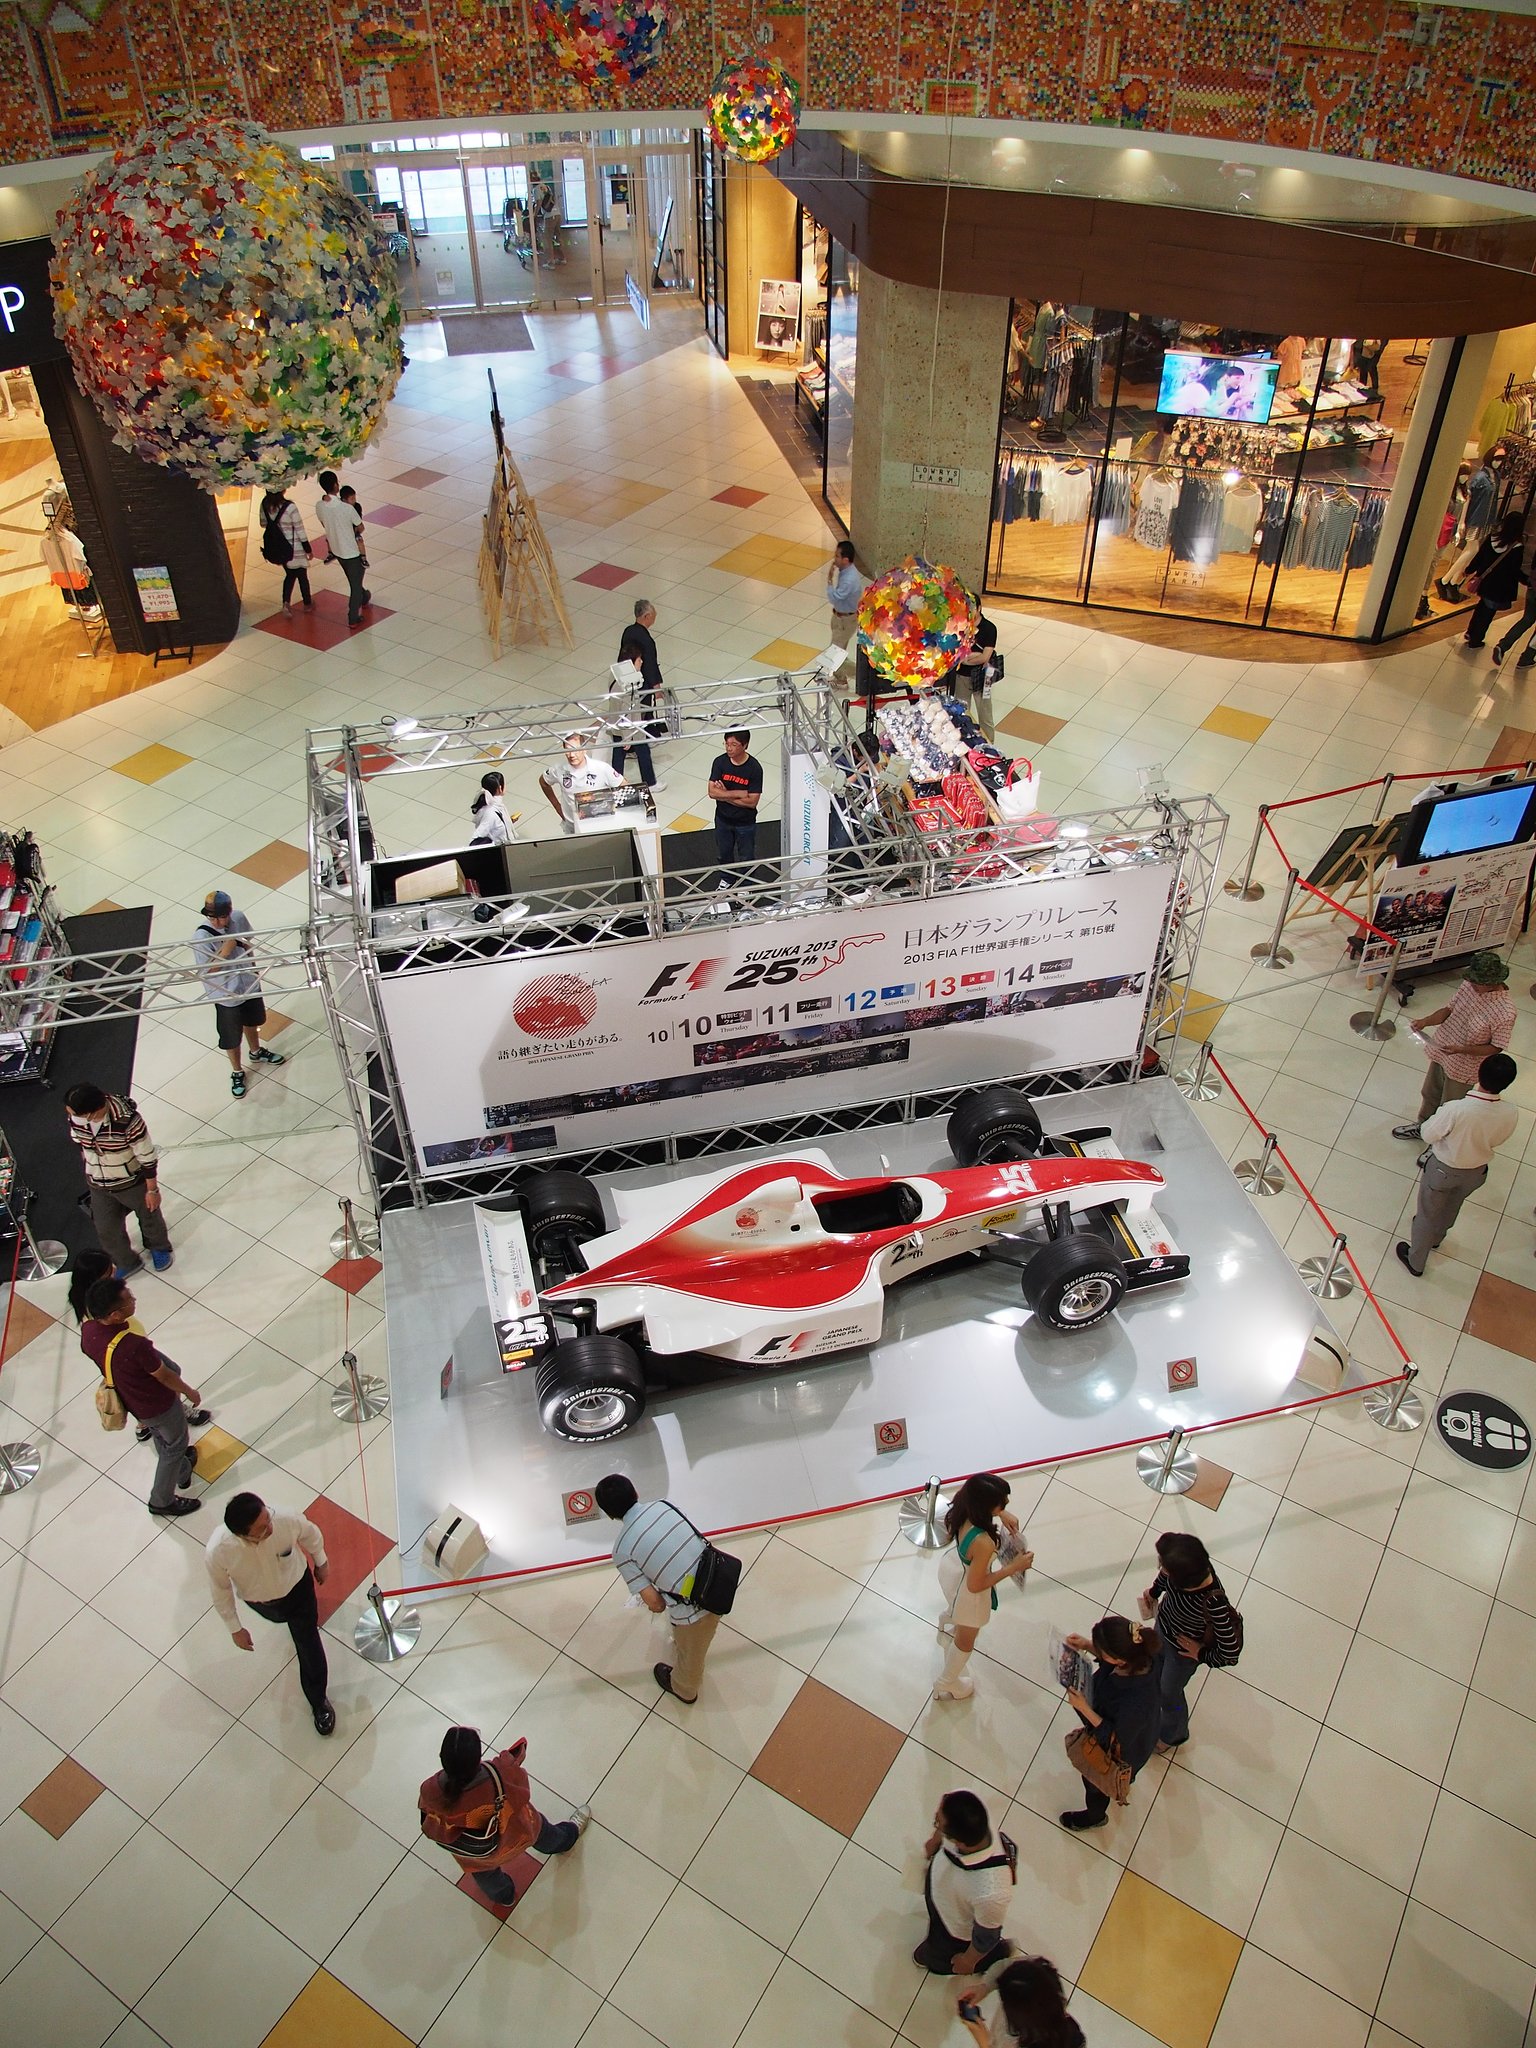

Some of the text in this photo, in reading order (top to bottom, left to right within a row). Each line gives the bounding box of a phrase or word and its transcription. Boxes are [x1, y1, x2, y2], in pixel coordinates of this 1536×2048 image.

[915, 466, 958, 477] LOWRYS
[919, 474, 953, 483] FARM
[1158, 569, 1203, 579] LOWRYS
[803, 799, 811, 832] SUZUKA
[904, 899, 1118, 949] 日本グランプリレース
[742, 939, 838, 963] SUZUKA 2013
[903, 923, 1115, 965] 2013 FIA F1世界選手権シリーズ 第15戦
[643, 956, 731, 998] F1
[1004, 964, 1035, 986] 14
[1042, 972, 1066, 981] Monday
[924, 976, 956, 998] 13
[966, 985, 988, 994] Sunday
[637, 995, 678, 1006] Formula
[844, 989, 877, 1011] 12
[883, 998, 911, 1007] Saturday
[762, 1003, 790, 1025] 11
[804, 1012, 824, 1020] Friday
[647, 1015, 712, 1044] 10 10
[720, 1024, 749, 1033] Thursday
[497, 1033, 623, 1061] 語り継ぎたい走りがある。
[1063, 1271, 1118, 1292] BRIDGESTONE
[826, 1324, 859, 1335] JAPANESE
[1056, 1310, 1109, 1330] POTENZA
[815, 1340, 837, 1348] SUZUKA
[821, 1327, 863, 1341] GRAND PRIX
[562, 1387, 627, 1407] BRIDGESTONE
[568, 1423, 629, 1443] POTENZA
[1471, 1410, 1483, 1447] Photo Spot
